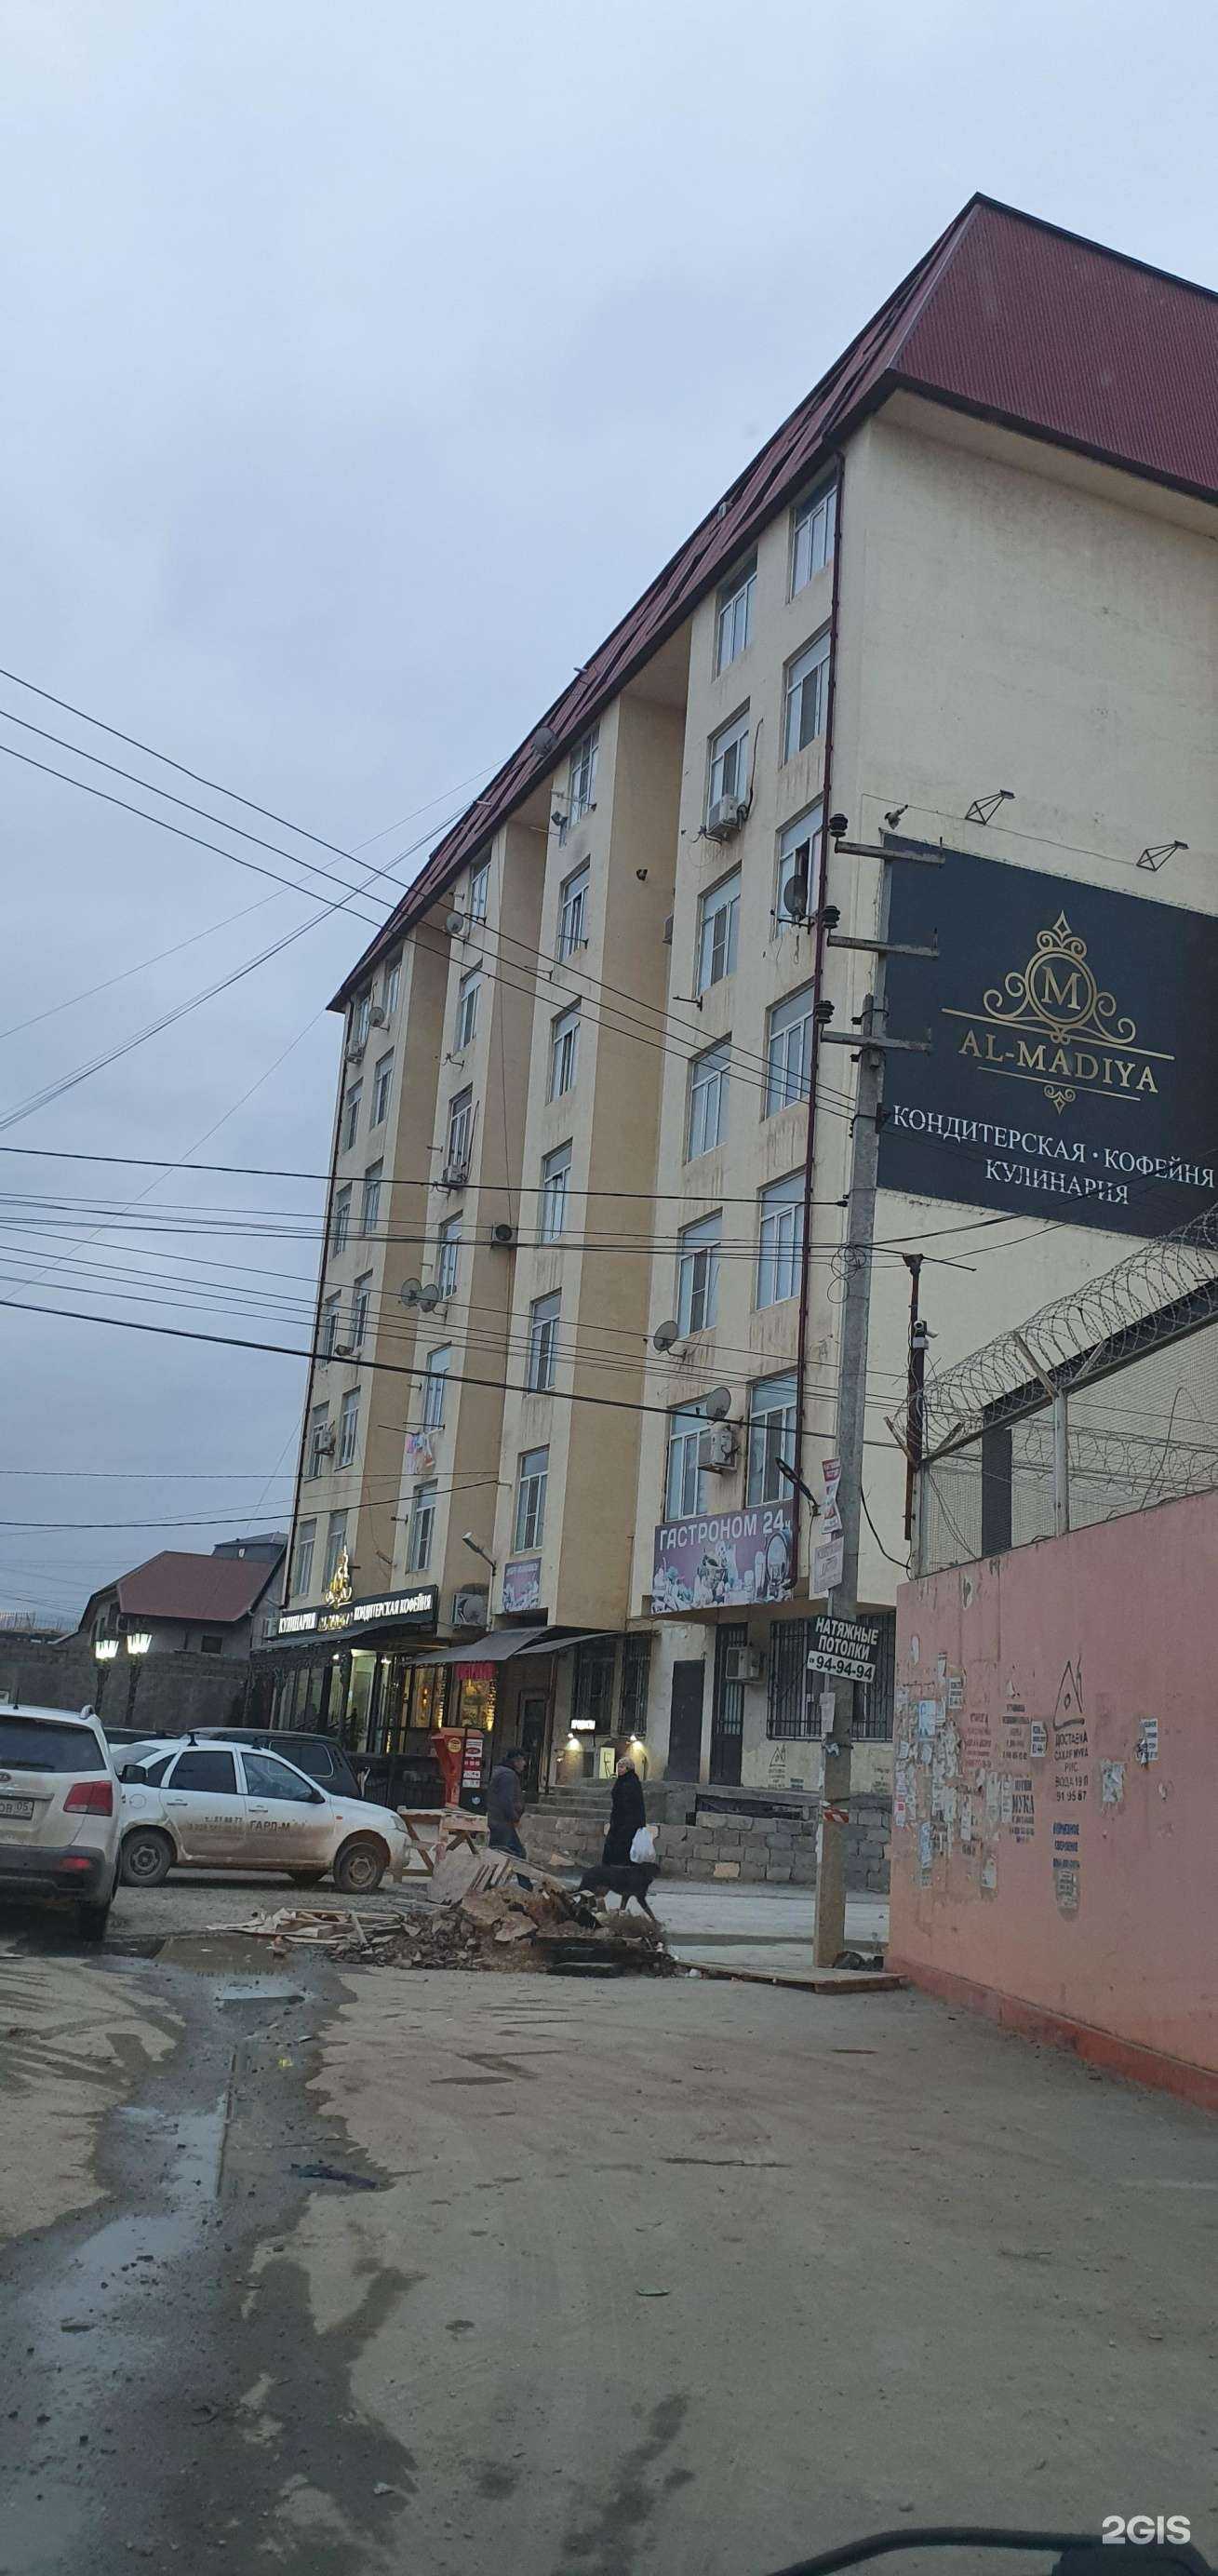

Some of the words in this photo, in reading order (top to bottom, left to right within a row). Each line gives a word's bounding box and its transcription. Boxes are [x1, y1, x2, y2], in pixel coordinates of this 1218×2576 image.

[1040, 966, 1082, 1011] M
[958, 1029, 1158, 1093] AL-MADIYA
[893, 1105, 1087, 1163] КОНДИТЕРСКАЯ
[1104, 1147, 1215, 1189] КОФЕЙНЯ
[985, 1159, 1130, 1206] КУЛИНАРИЯ
[660, 1513, 757, 1551] ГАСТРОНОМ
[815, 1617, 879, 1645] НАТЯЖНЫЕ
[818, 1634, 871, 1661] ПОТОЛКИ
[816, 1655, 873, 1681] 94-94-94
